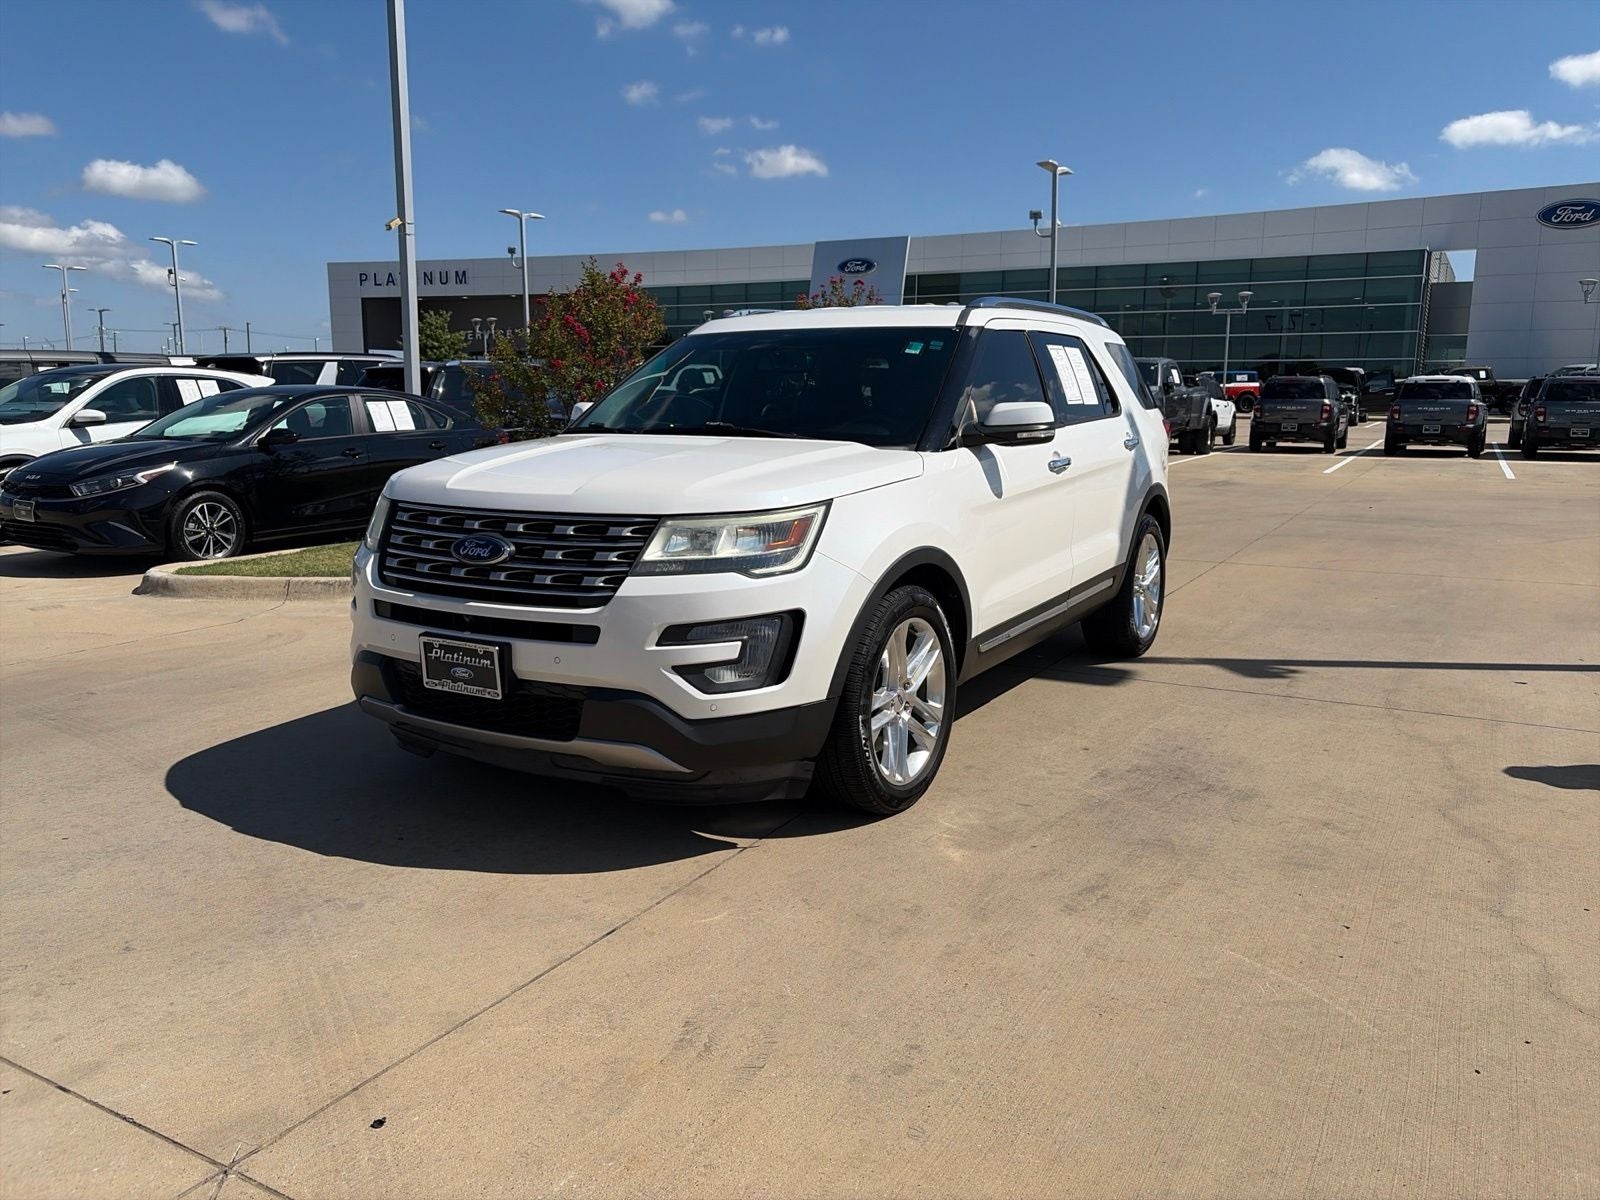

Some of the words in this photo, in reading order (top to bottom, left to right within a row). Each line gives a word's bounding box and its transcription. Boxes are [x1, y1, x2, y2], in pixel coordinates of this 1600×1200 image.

[1552, 206, 1595, 223] Ford
[845, 261, 867, 272] Ford
[359, 270, 468, 287] PLANUM
[460, 539, 493, 557] Ford
[428, 648, 494, 669] Platinum
